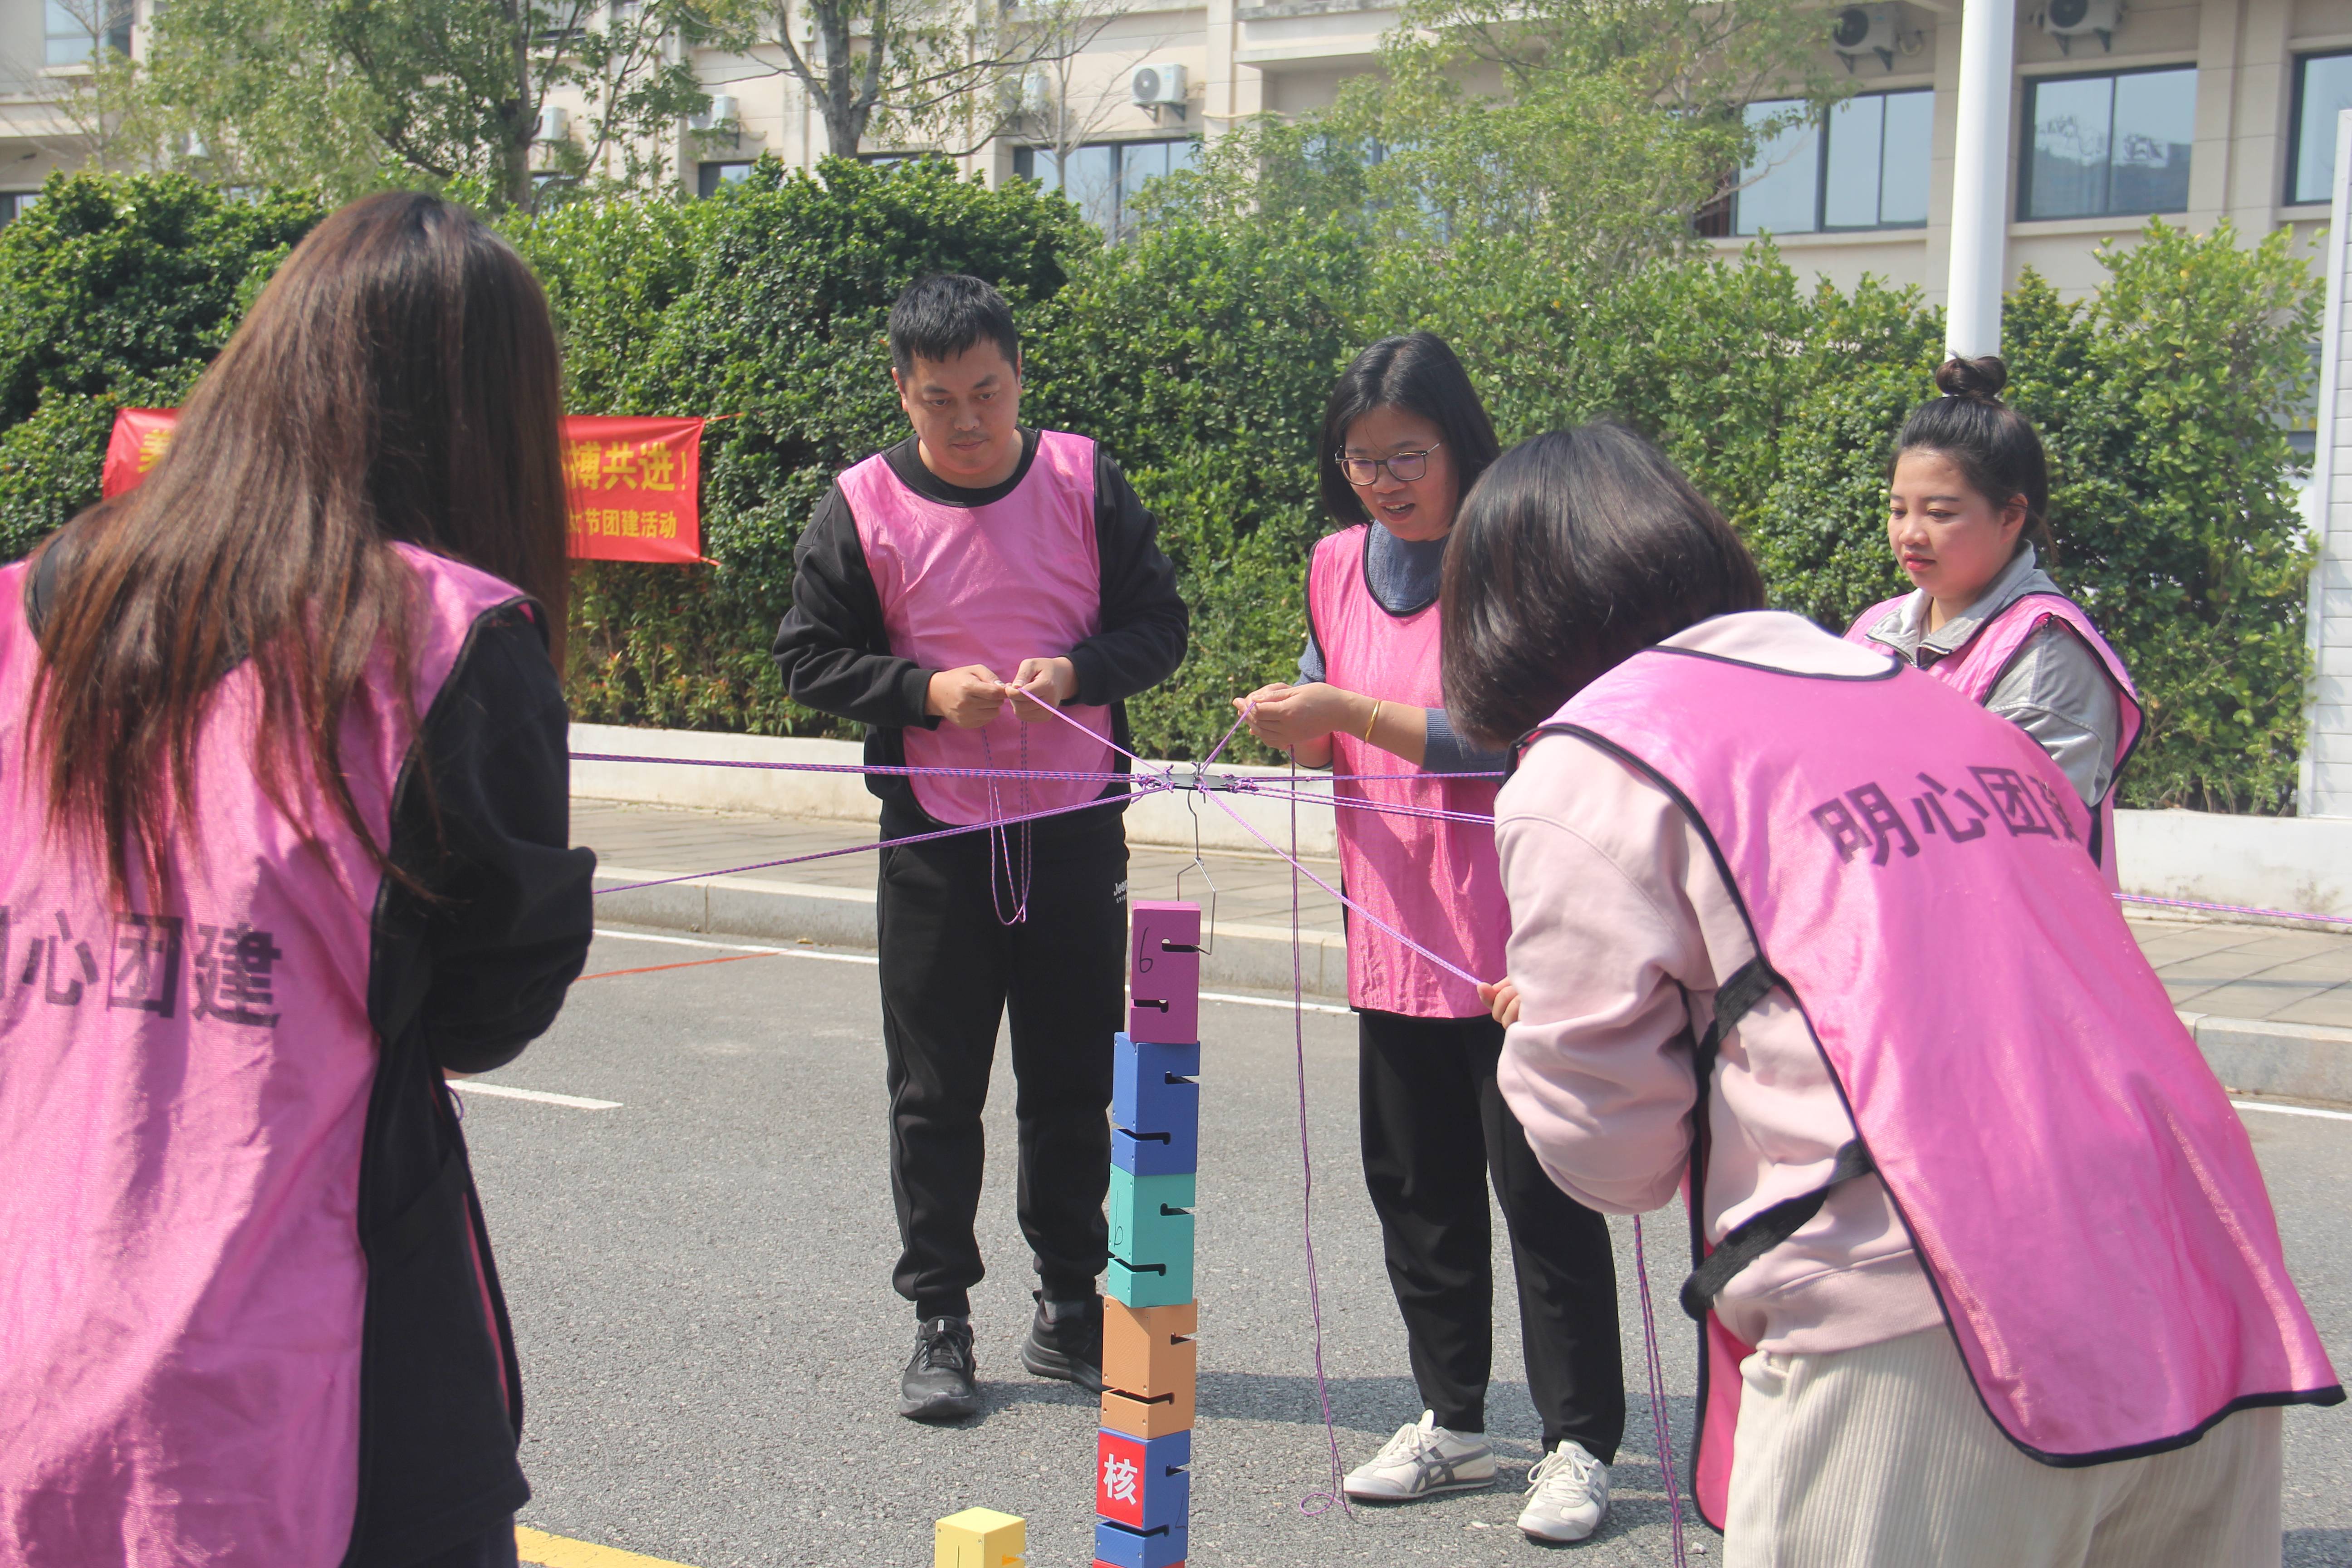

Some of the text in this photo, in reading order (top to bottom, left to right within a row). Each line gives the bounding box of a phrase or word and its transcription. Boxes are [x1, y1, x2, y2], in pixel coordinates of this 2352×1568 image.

[0, 905, 282, 1029] 心团建
[1139, 926, 1153, 973] 6
[1102, 1453, 1138, 1506] 核
